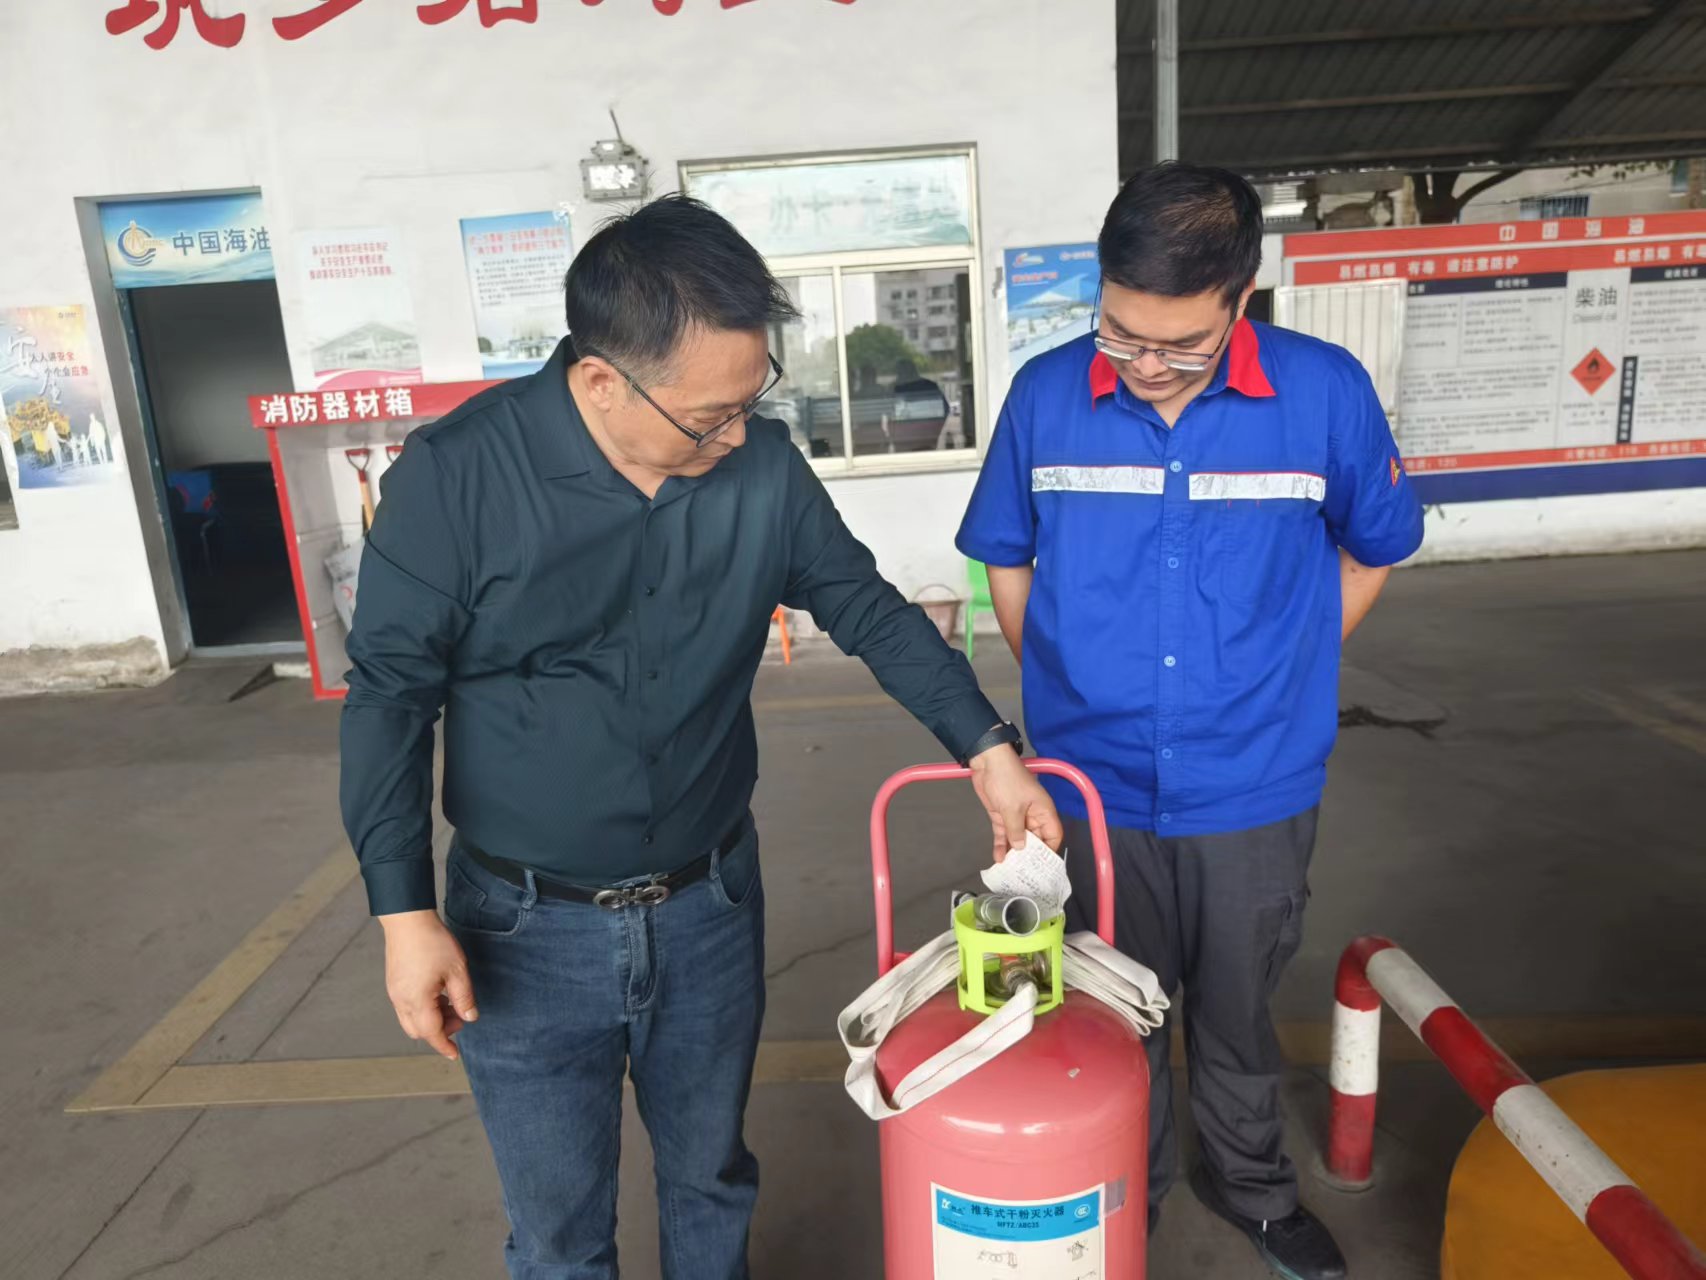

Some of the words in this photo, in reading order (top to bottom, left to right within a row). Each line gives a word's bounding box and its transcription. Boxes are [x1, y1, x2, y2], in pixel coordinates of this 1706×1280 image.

[172, 226, 272, 256] 中国海油
[1575, 286, 1617, 308] 柴油
[259, 388, 414, 424] 消防器材箱
[970, 1204, 1065, 1220] 推车式干粉灭火器
